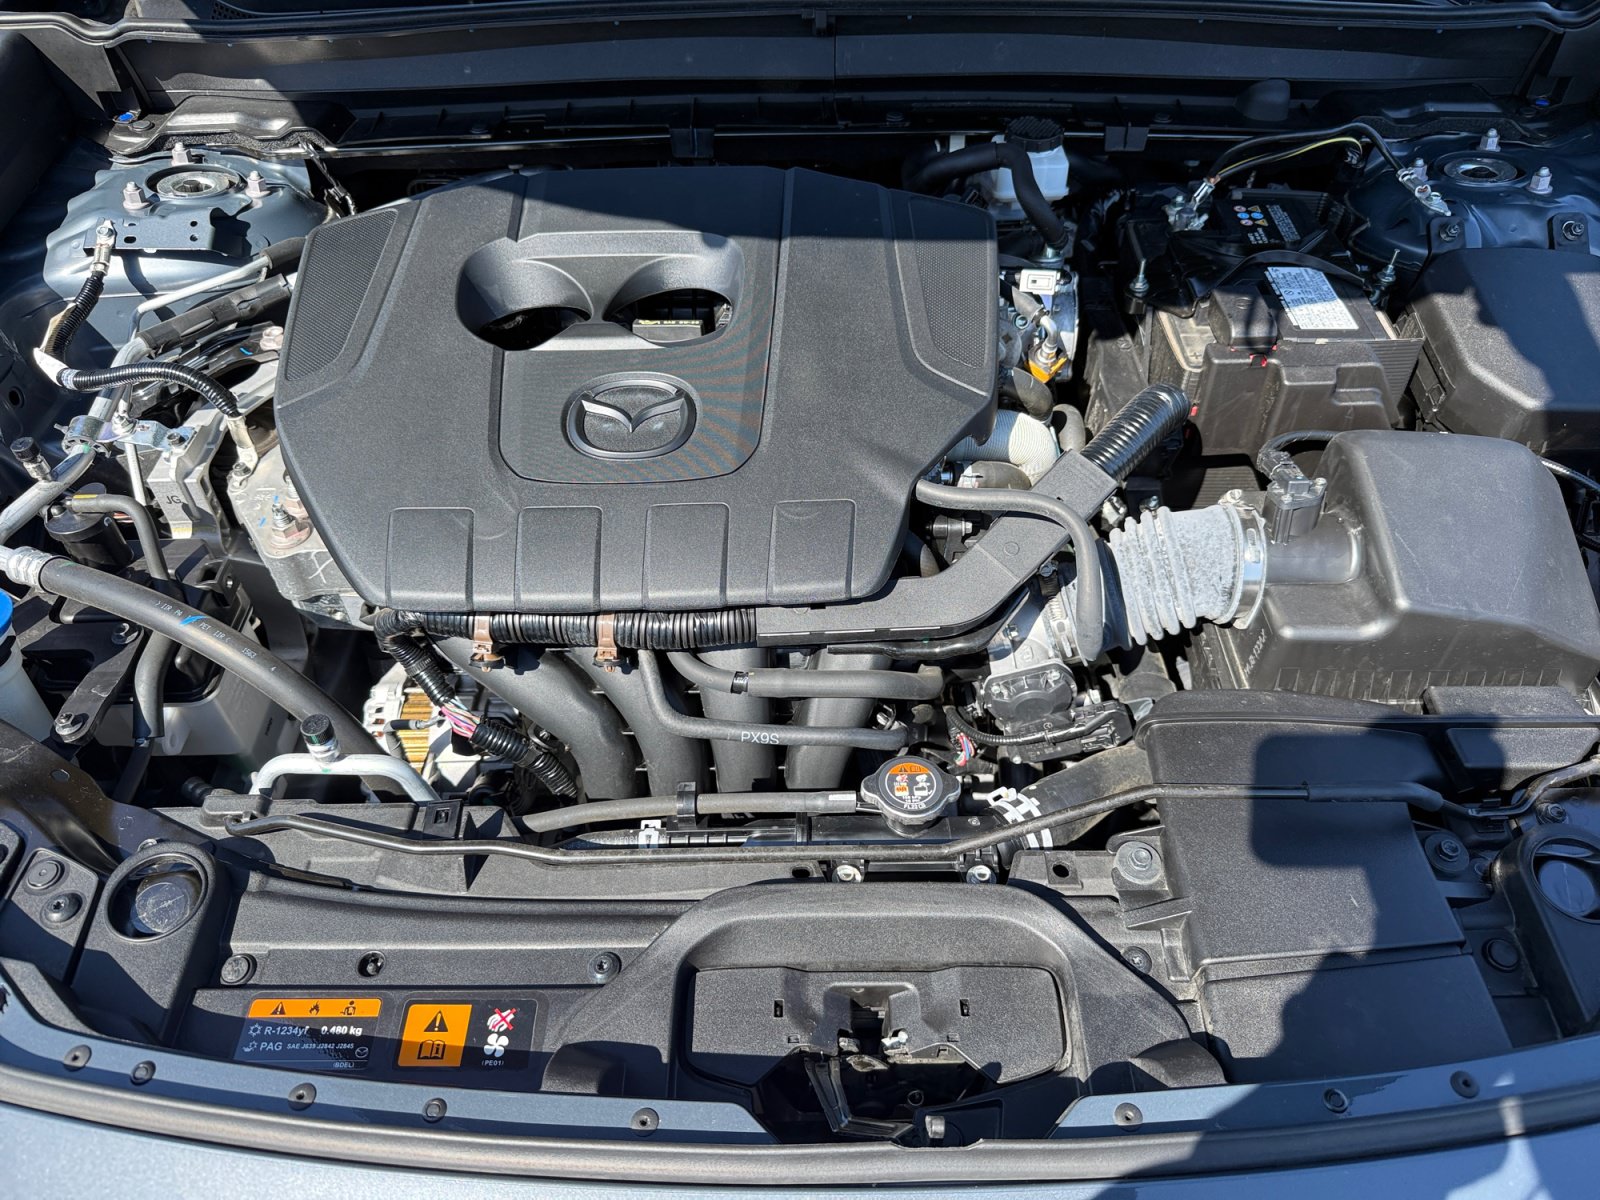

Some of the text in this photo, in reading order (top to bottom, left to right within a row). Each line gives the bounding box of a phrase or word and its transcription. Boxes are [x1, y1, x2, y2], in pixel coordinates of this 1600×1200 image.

[165, 495, 183, 504] JG
[741, 730, 780, 745] PX9S
[263, 1025, 363, 1037] R-1234yf 0.480 kg
[260, 1041, 283, 1051] PAG
